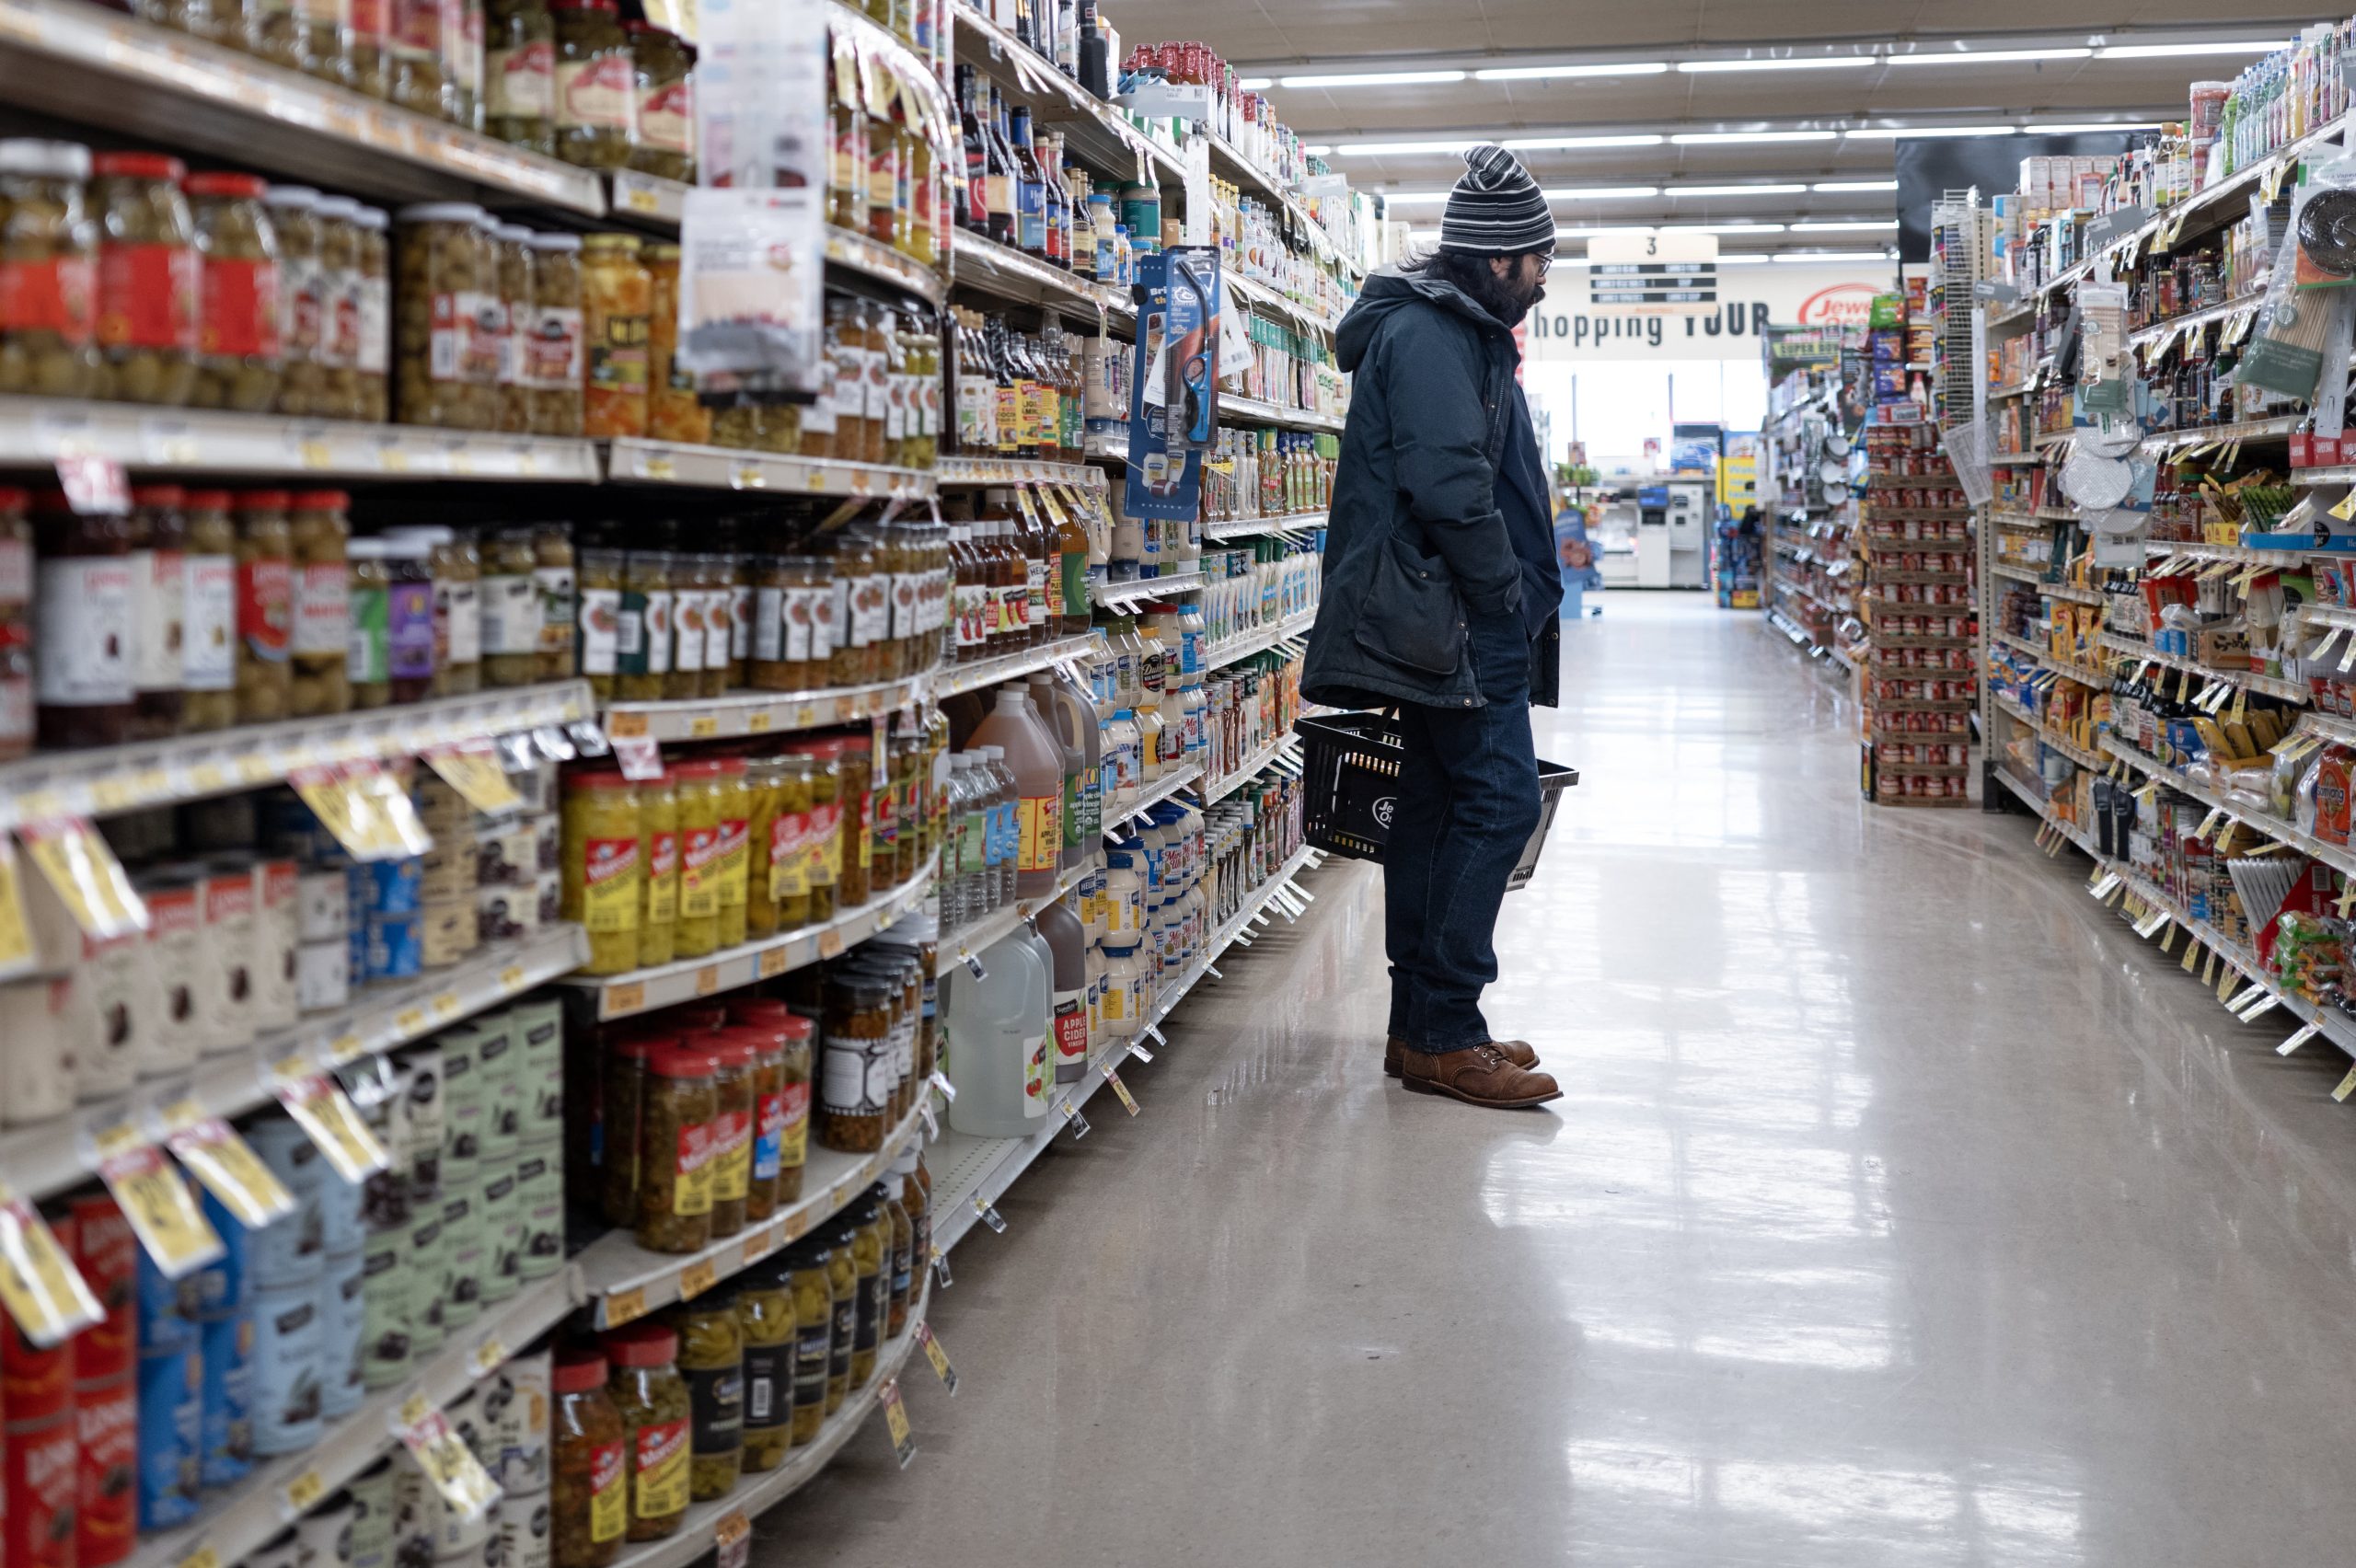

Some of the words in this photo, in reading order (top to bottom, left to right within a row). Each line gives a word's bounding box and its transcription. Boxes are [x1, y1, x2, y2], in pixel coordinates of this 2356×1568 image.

[1646, 236, 1657, 256] 3
[1149, 286, 1167, 295] Bri
[1063, 1016, 1086, 1031] APPLE
[1064, 1028, 1086, 1041] CIDER
